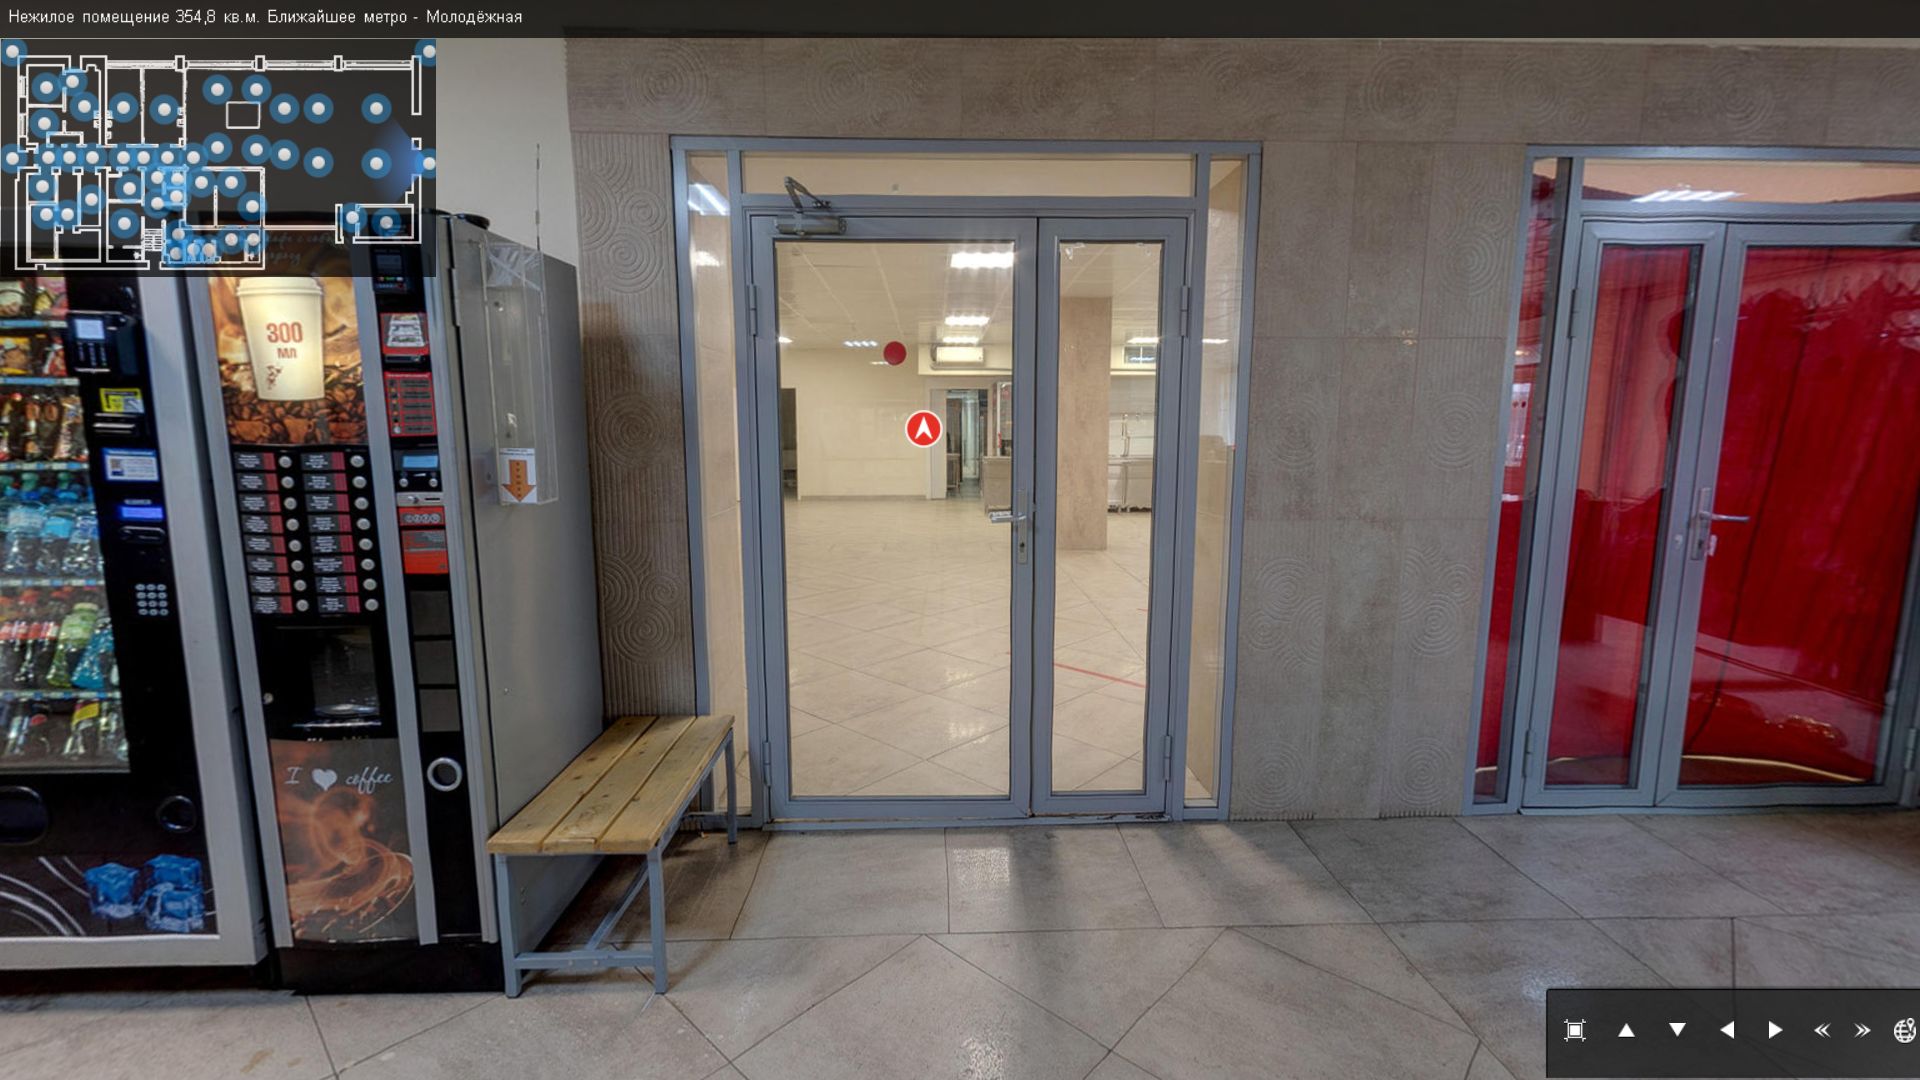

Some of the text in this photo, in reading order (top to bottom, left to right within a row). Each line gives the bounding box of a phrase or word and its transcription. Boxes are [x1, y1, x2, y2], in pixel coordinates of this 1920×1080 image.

[266, 321, 303, 343] 300
[284, 766, 393, 795] I coffee
